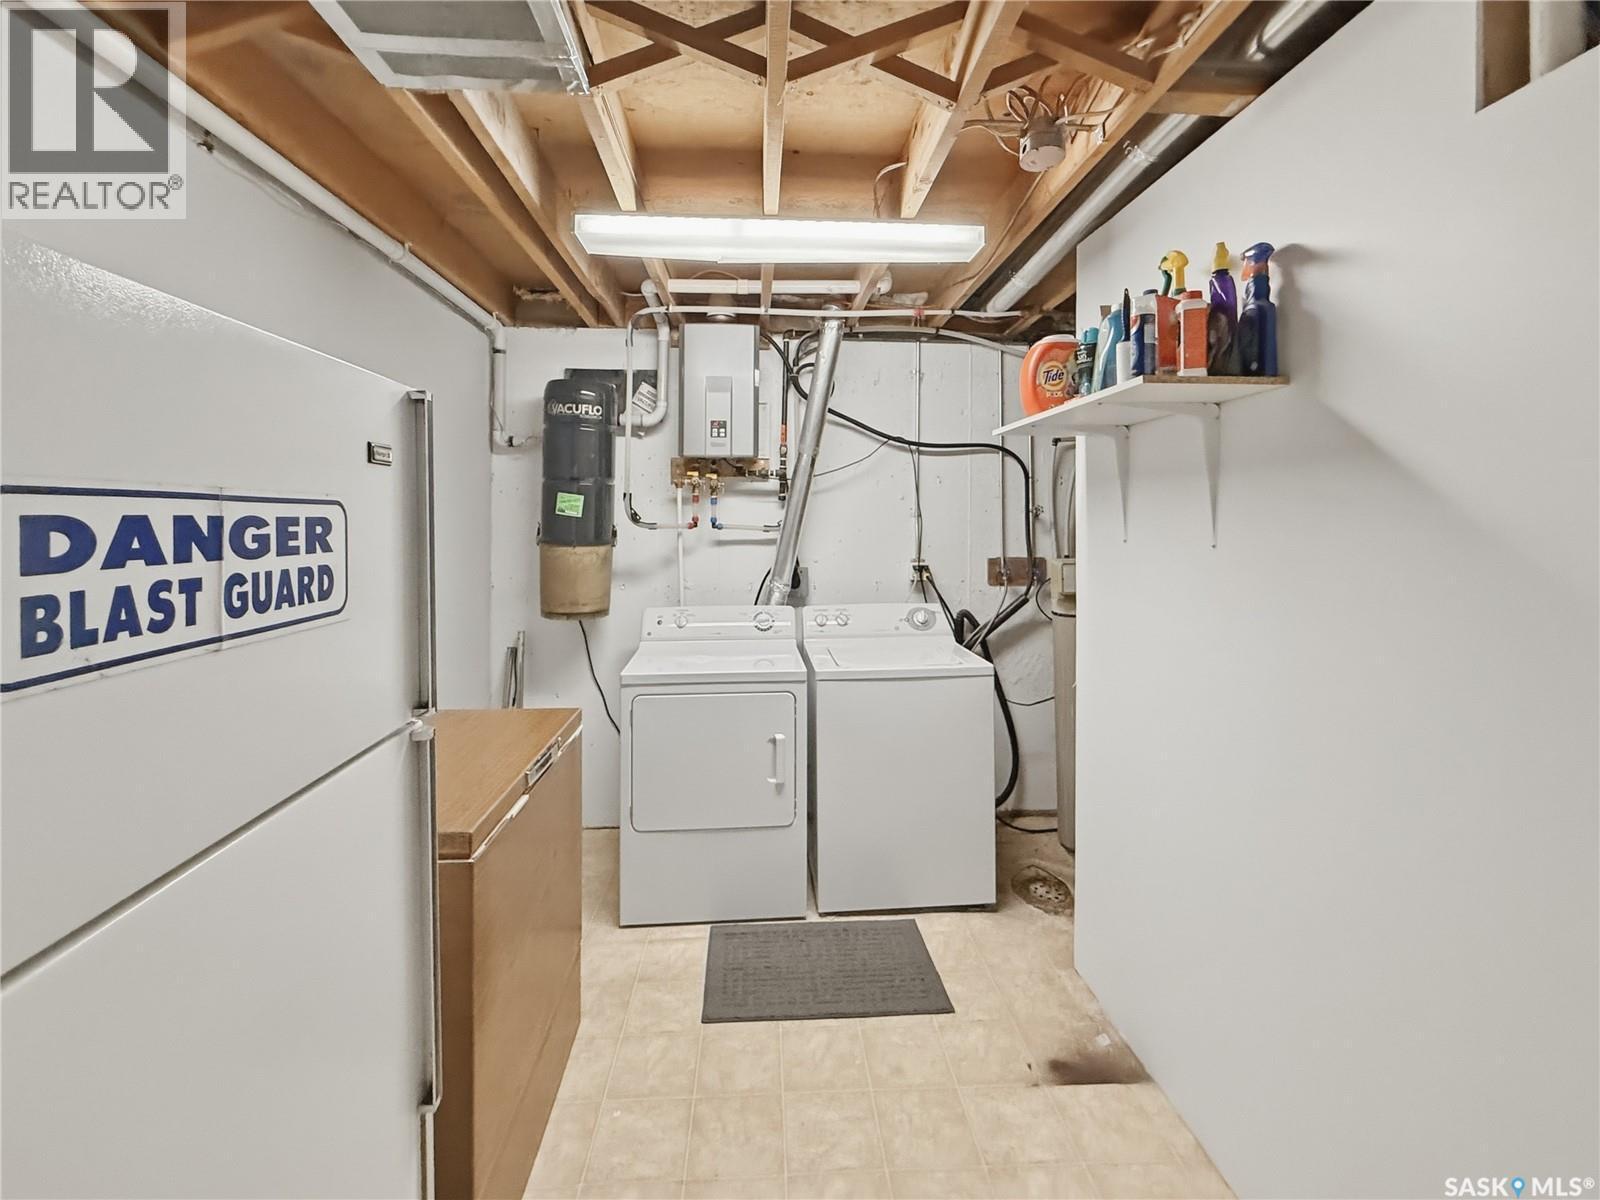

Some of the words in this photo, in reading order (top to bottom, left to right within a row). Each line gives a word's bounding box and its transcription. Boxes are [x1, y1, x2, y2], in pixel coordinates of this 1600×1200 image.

[1043, 368, 1064, 386] Tide
[550, 402, 602, 416] VACUFLO
[19, 514, 334, 577] DANGER
[20, 577, 204, 659] BLAST
[224, 564, 335, 620] GUARD
